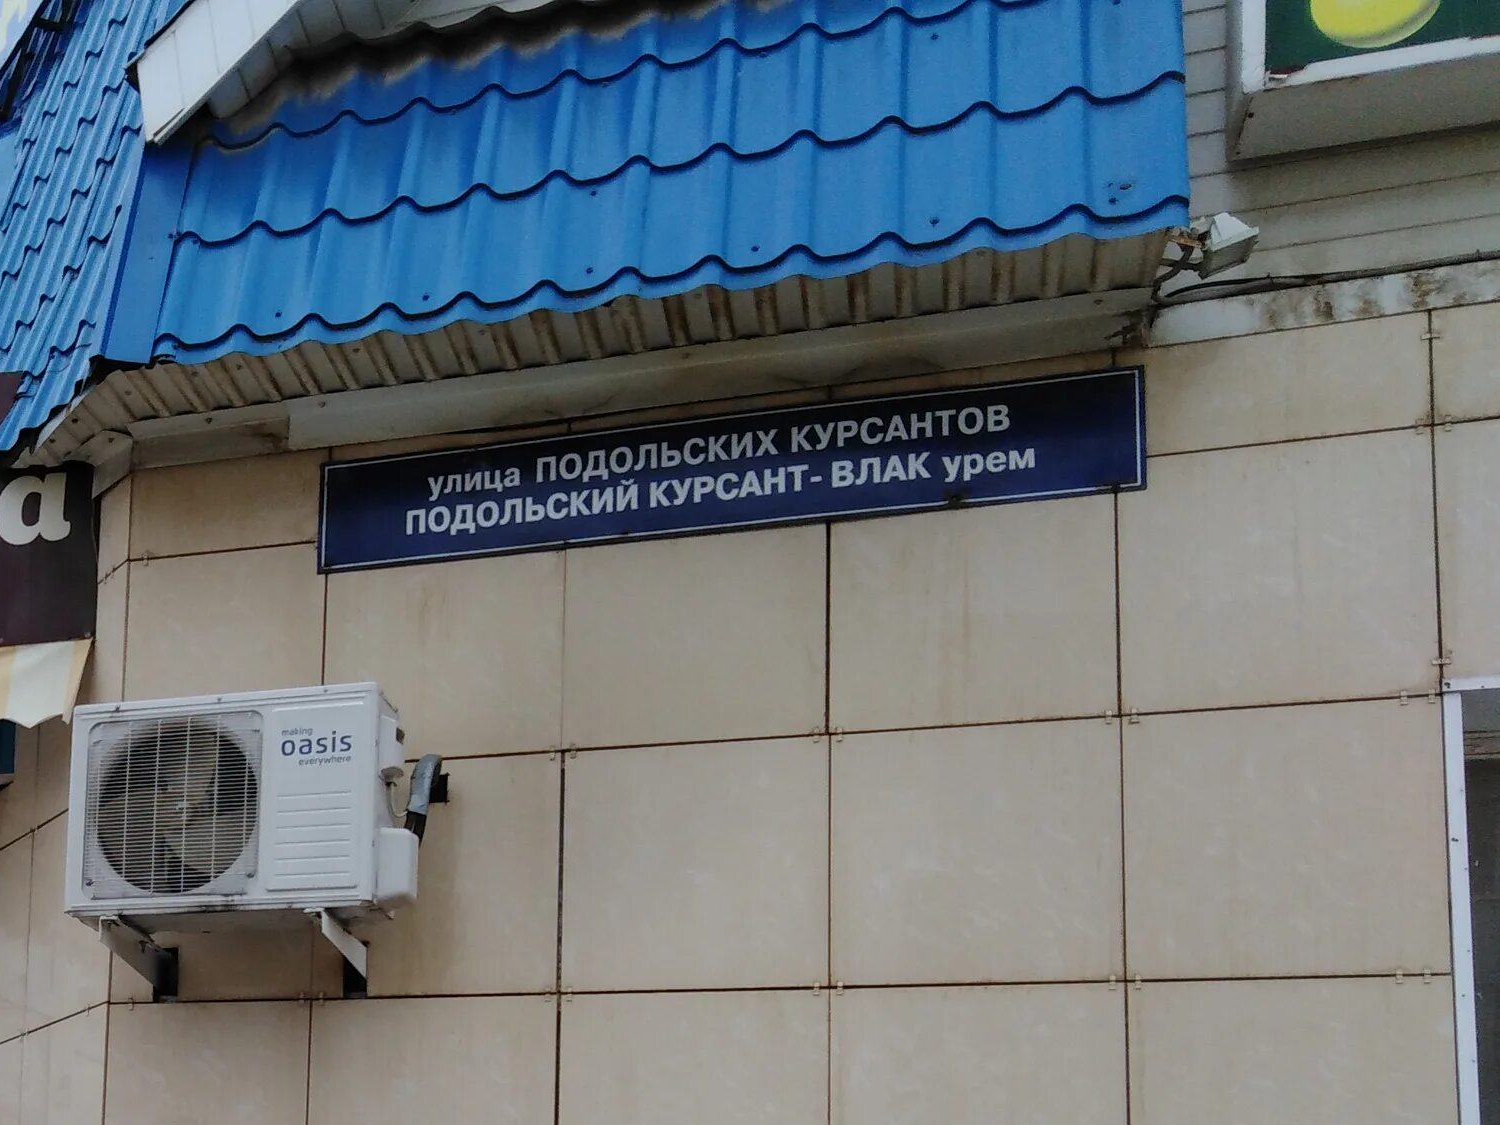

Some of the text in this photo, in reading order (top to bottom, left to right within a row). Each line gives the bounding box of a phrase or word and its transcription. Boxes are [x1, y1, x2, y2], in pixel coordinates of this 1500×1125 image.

[427, 404, 1011, 502] улица ПОДОЛЬСКИХ КУРСАНТОВ
[405, 478, 639, 536] ПОДОЛЬСКИЙ
[831, 451, 932, 489] ВЛАК
[941, 447, 1036, 483] урем
[281, 727, 313, 737] making
[281, 730, 352, 756] oasis
[298, 755, 352, 767] everywhere
